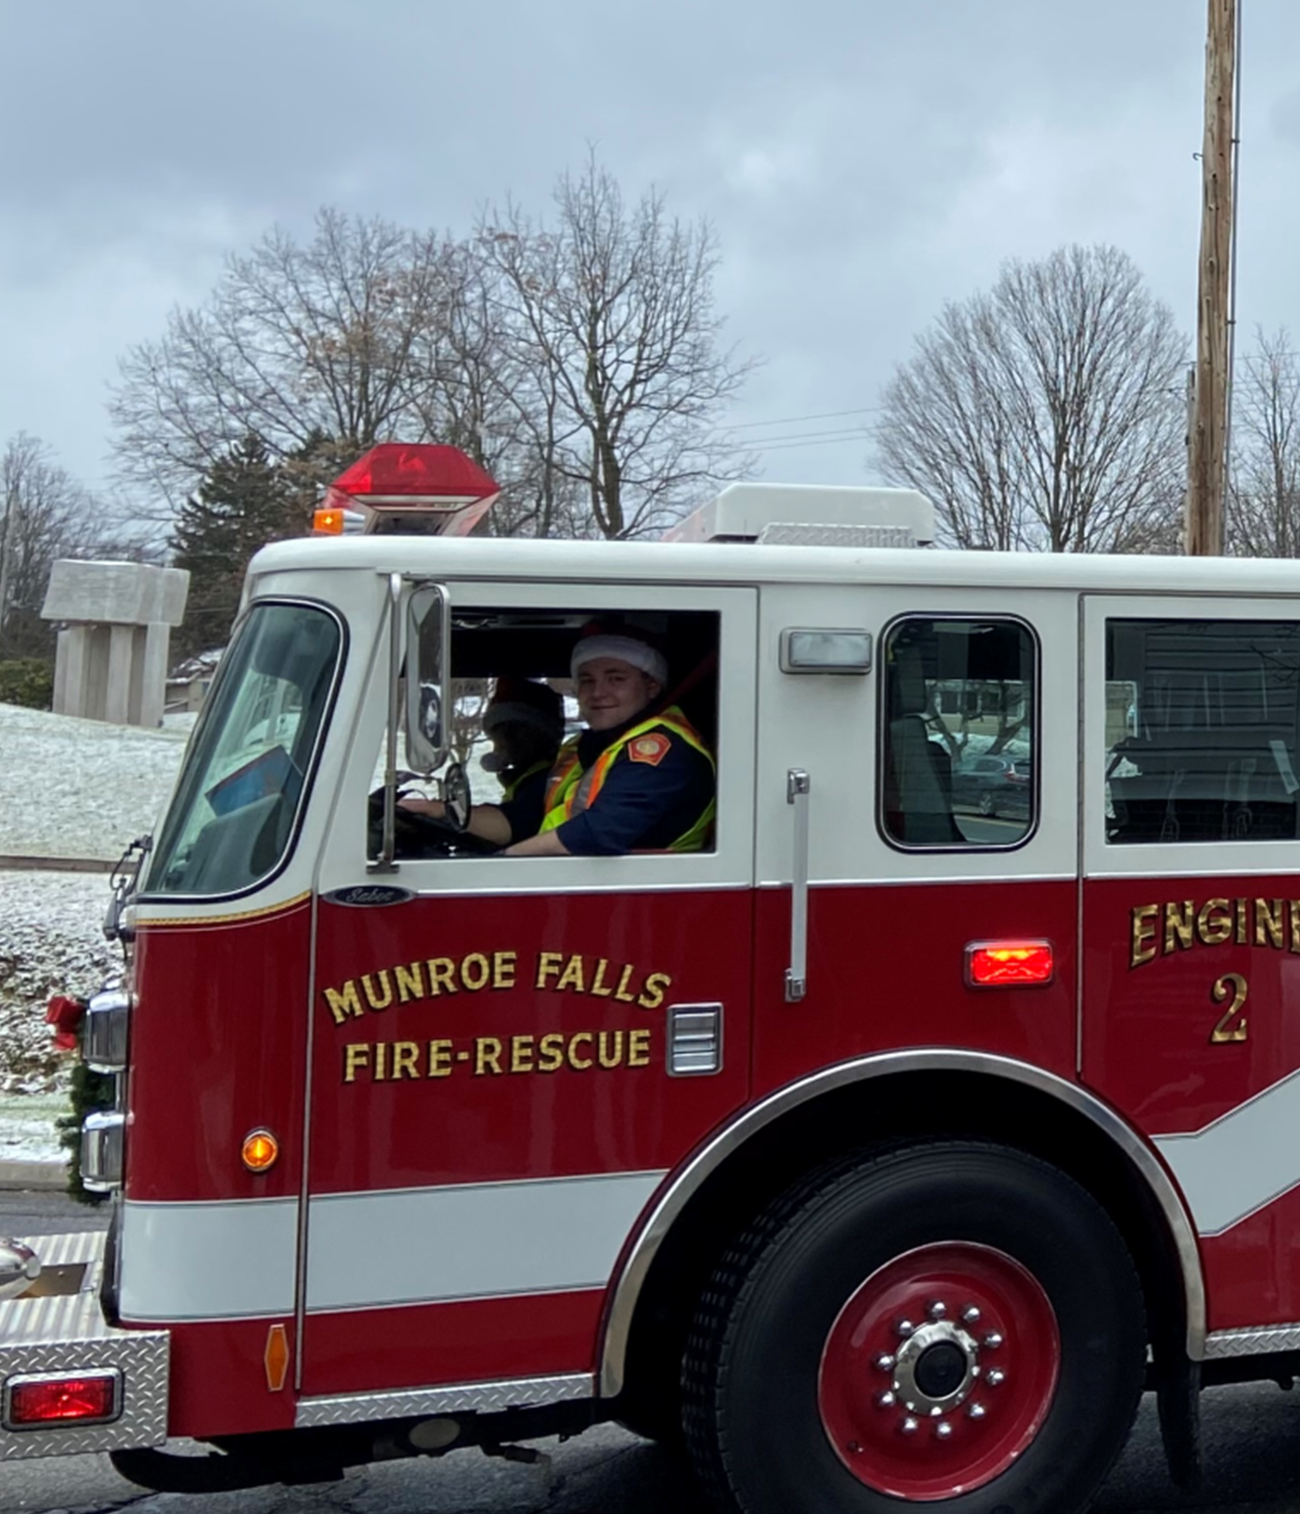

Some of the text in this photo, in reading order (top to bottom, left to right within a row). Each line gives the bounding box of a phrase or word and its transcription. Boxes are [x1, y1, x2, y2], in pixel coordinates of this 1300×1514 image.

[324, 951, 672, 1025] MUNROE FALLS
[1211, 972, 1248, 1043] 2
[344, 1029, 652, 1082] FIRE-RESCUE
